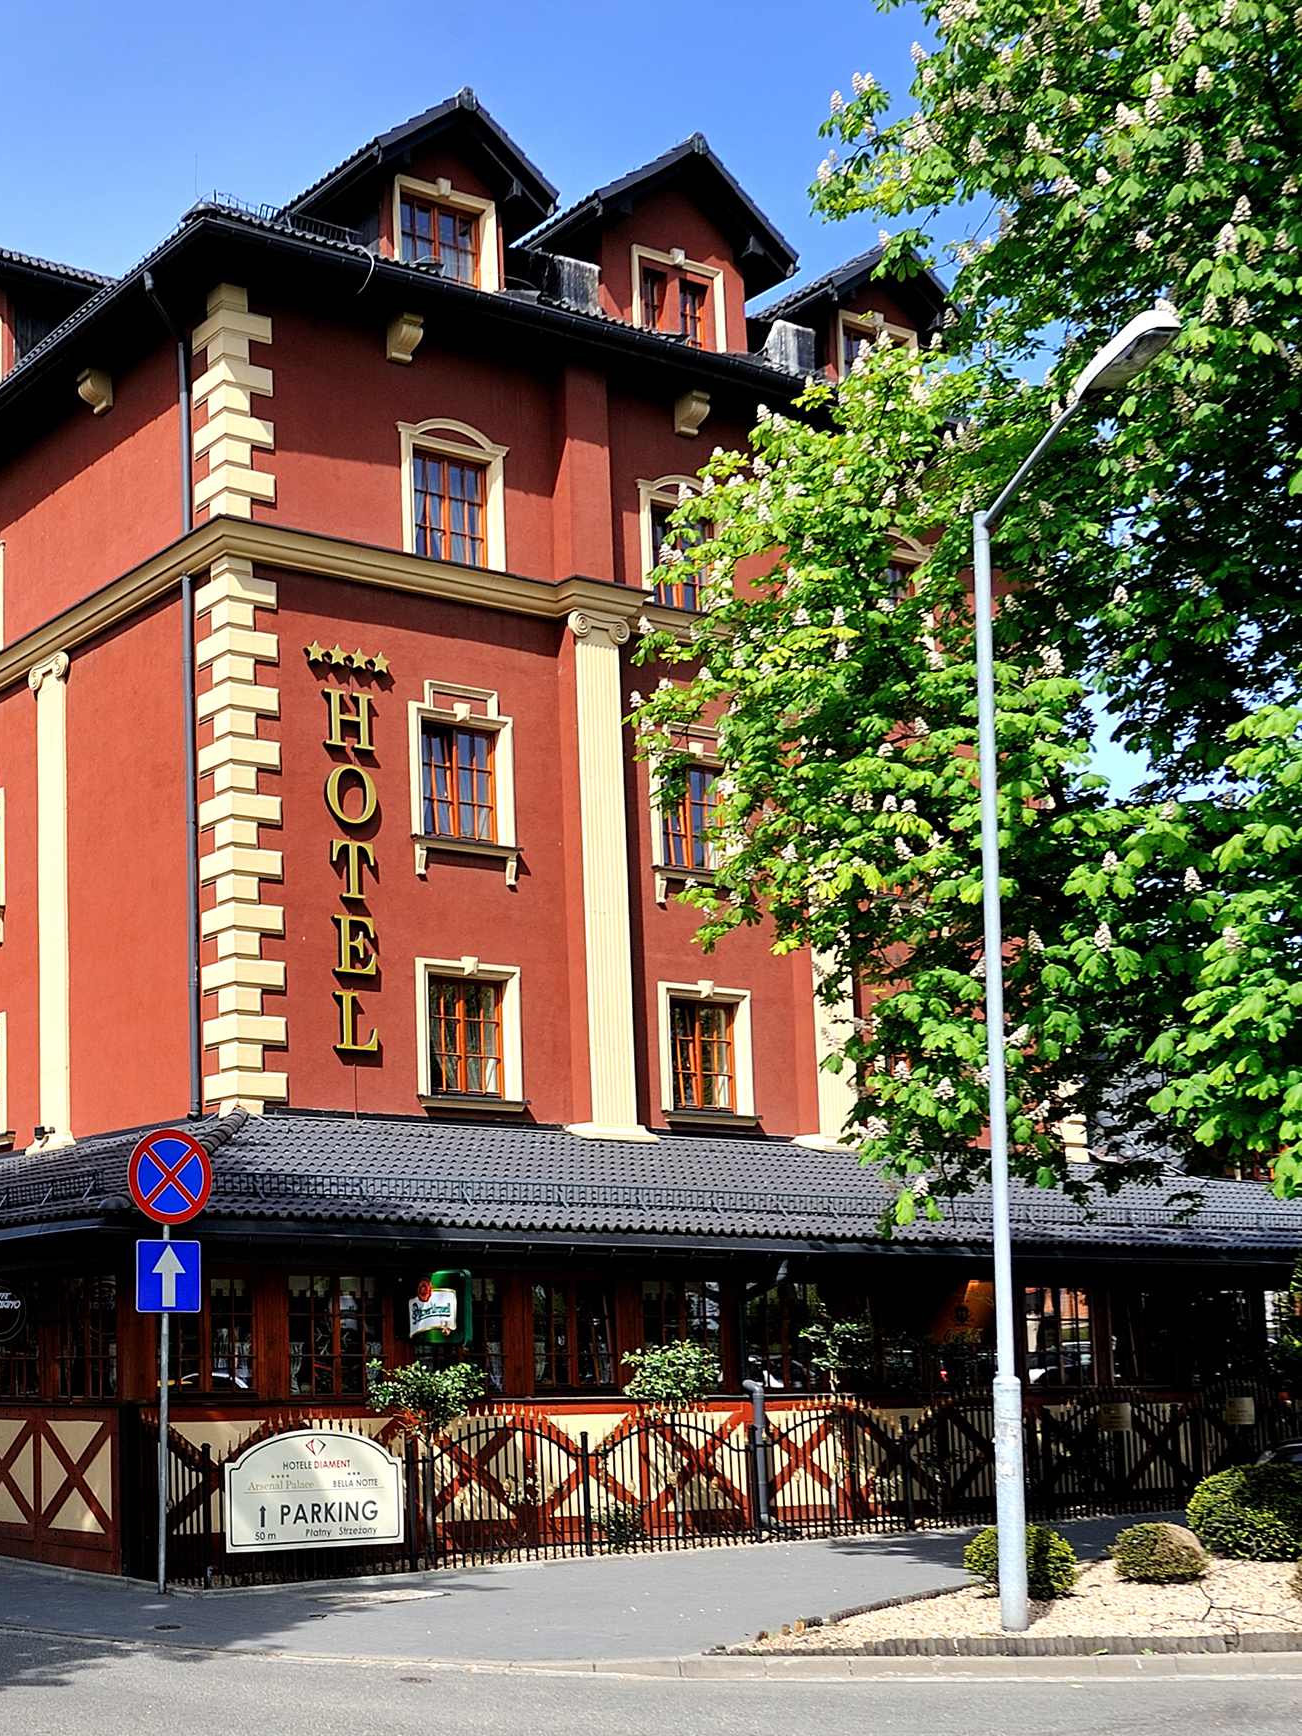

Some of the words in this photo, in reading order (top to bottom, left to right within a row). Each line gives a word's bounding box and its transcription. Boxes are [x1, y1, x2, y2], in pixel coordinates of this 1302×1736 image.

[325, 688, 379, 1052] HOTEL
[283, 1461, 312, 1470] HOTELE
[314, 1459, 351, 1469] DIAMENT
[248, 1481, 284, 1491] Arsenal
[286, 1480, 314, 1490] Palace
[333, 1479, 354, 1488] BELLA
[356, 1478, 379, 1487] NOTTE
[280, 1500, 379, 1525] PARKING
[255, 1532, 265, 1541] 50
[268, 1532, 276, 1540] m
[339, 1526, 378, 1536] Strzeżony
